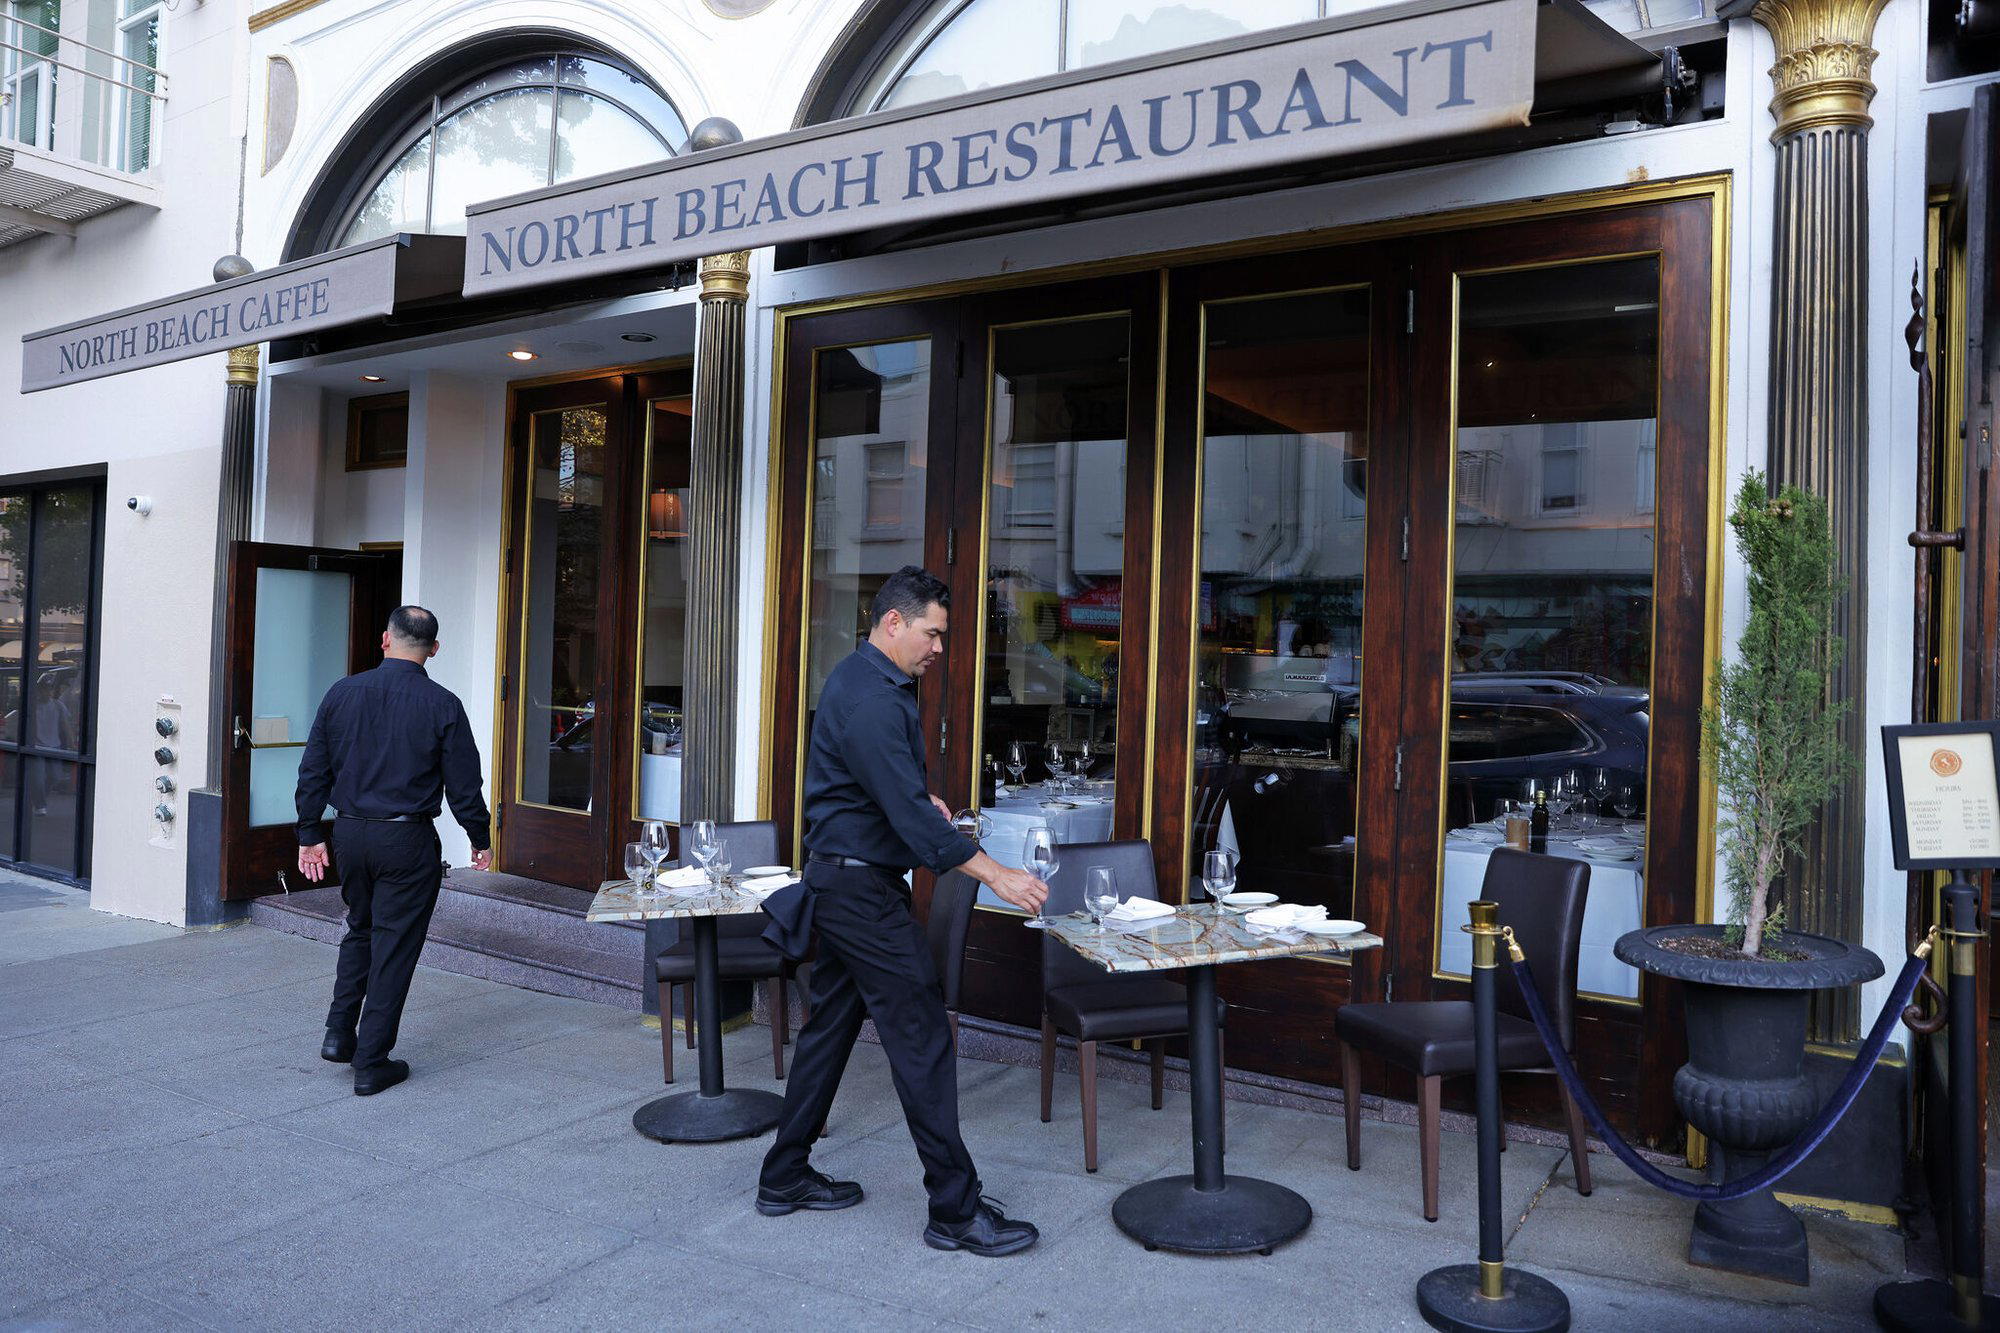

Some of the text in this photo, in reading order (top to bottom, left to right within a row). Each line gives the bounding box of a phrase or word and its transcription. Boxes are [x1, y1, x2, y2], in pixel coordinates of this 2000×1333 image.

[481, 30, 1493, 276] NORTH BEACH RESTAURANT
[58, 277, 330, 374] NORTH BEACH CAFFE
